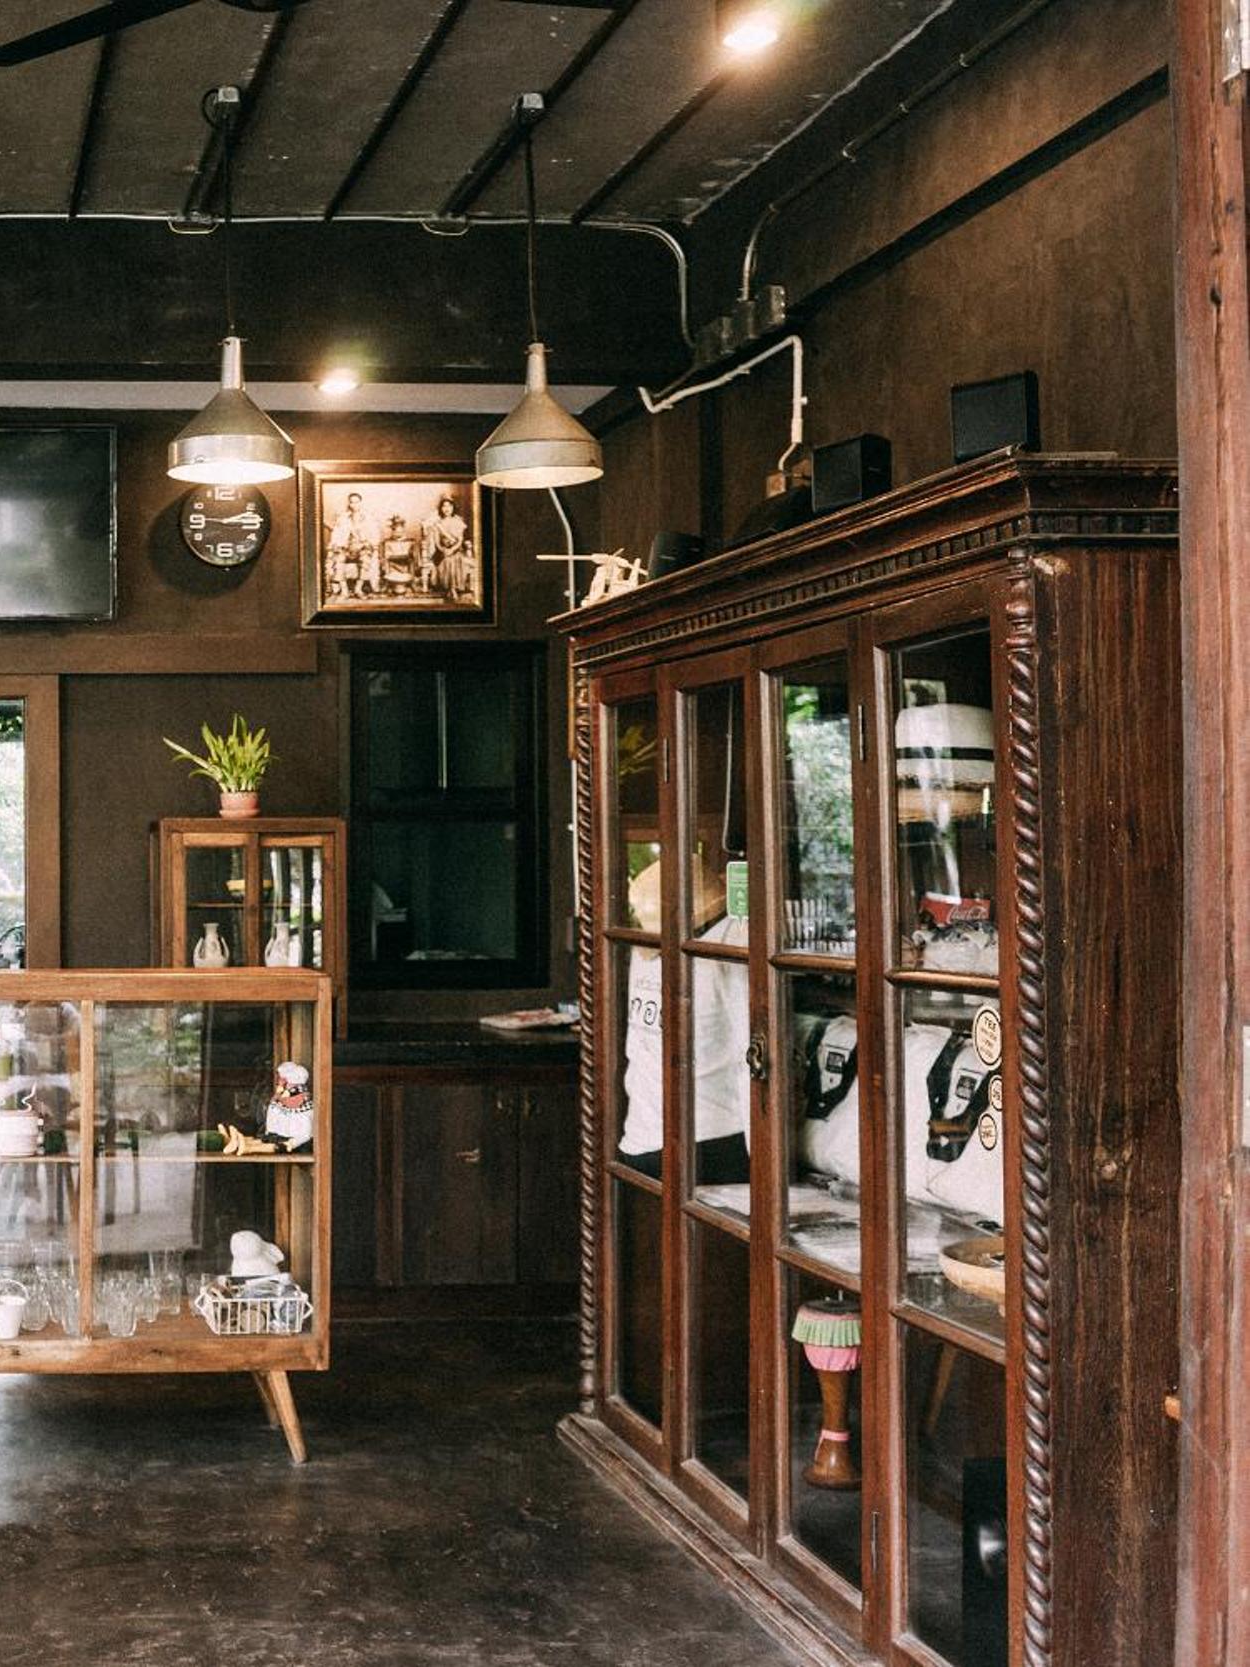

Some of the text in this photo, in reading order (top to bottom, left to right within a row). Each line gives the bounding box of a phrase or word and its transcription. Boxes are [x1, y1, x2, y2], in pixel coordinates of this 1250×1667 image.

[214, 486, 236, 501] 12
[189, 514, 206, 530] 9
[241, 514, 261, 530] 3
[206, 545, 214, 553] 7
[216, 542, 234, 557] 6
